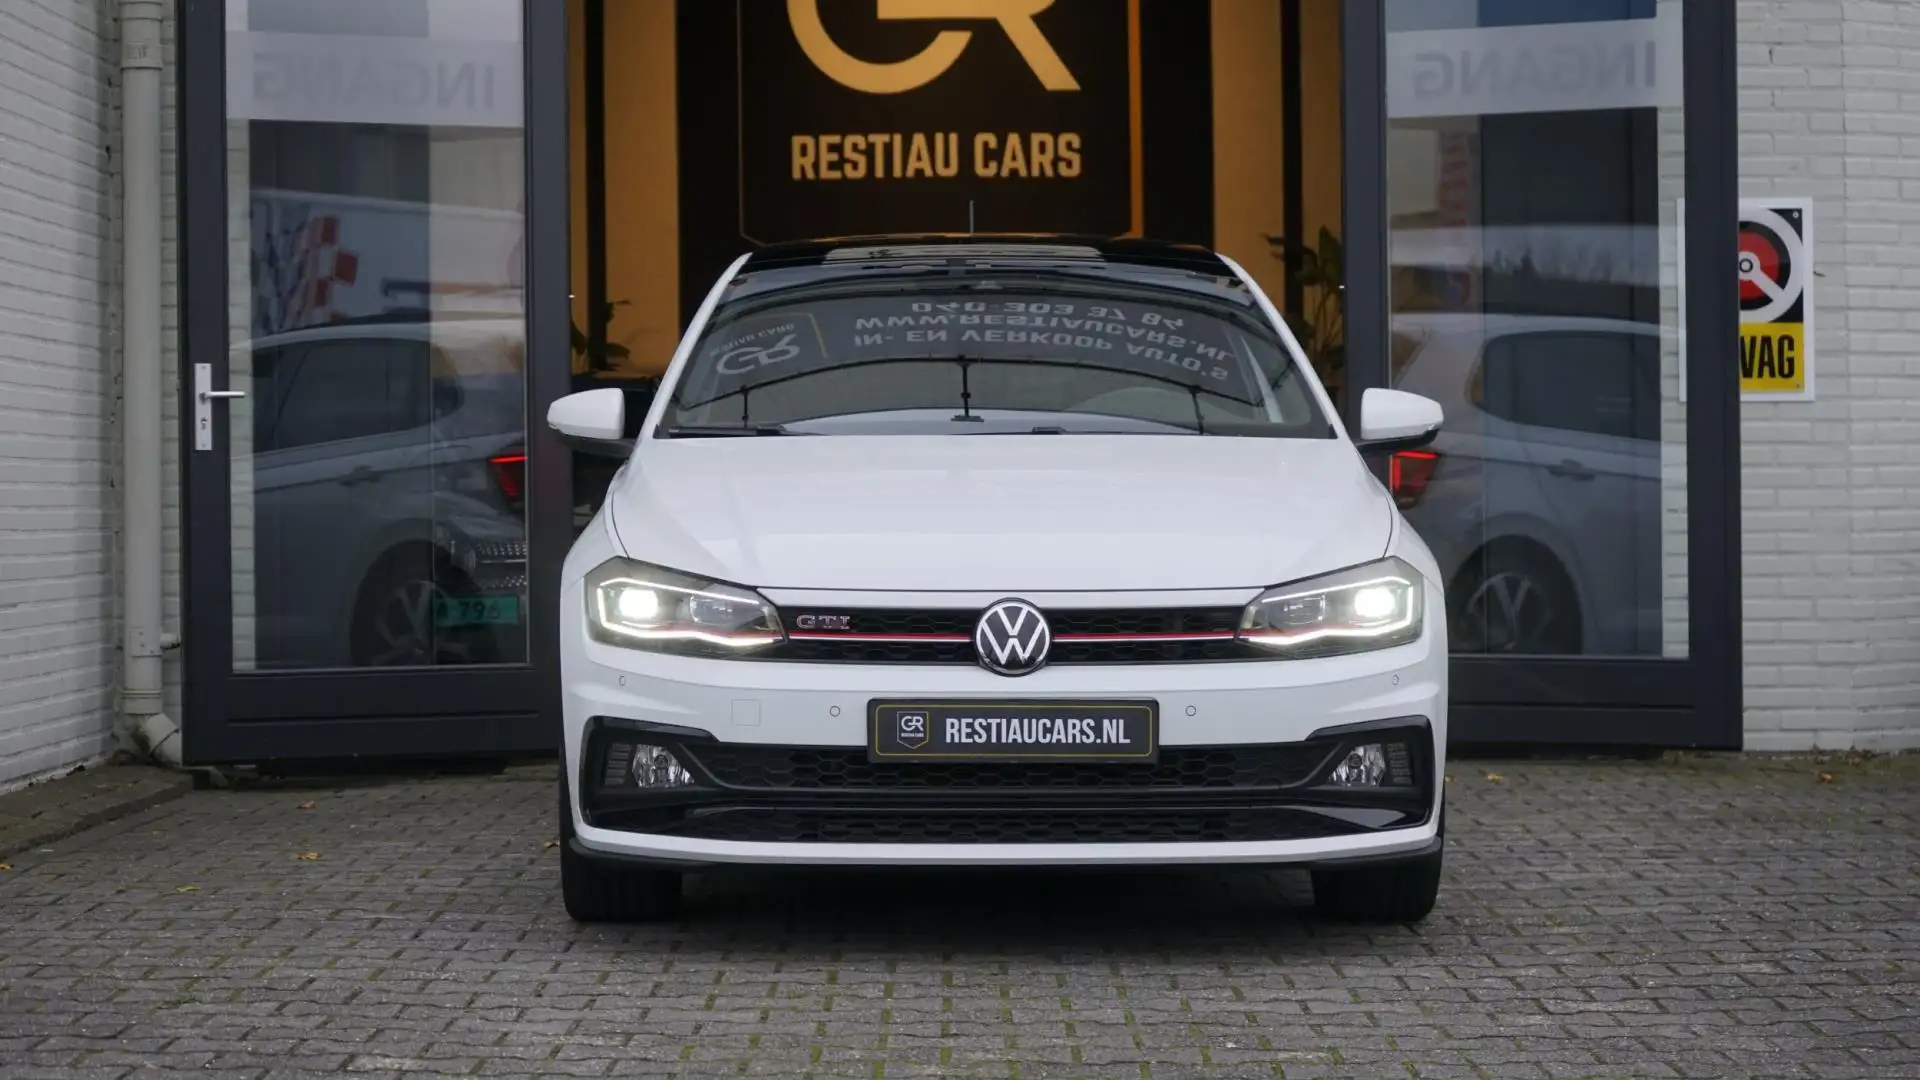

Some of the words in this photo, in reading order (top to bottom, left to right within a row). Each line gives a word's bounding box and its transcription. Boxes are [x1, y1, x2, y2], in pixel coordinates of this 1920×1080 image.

[791, 132, 958, 180] RESTIAU
[974, 132, 1082, 178] CARS
[1740, 334, 1795, 379] VAG
[796, 614, 850, 630] GTI
[945, 718, 1131, 744] RESTIAUCARS.NL
